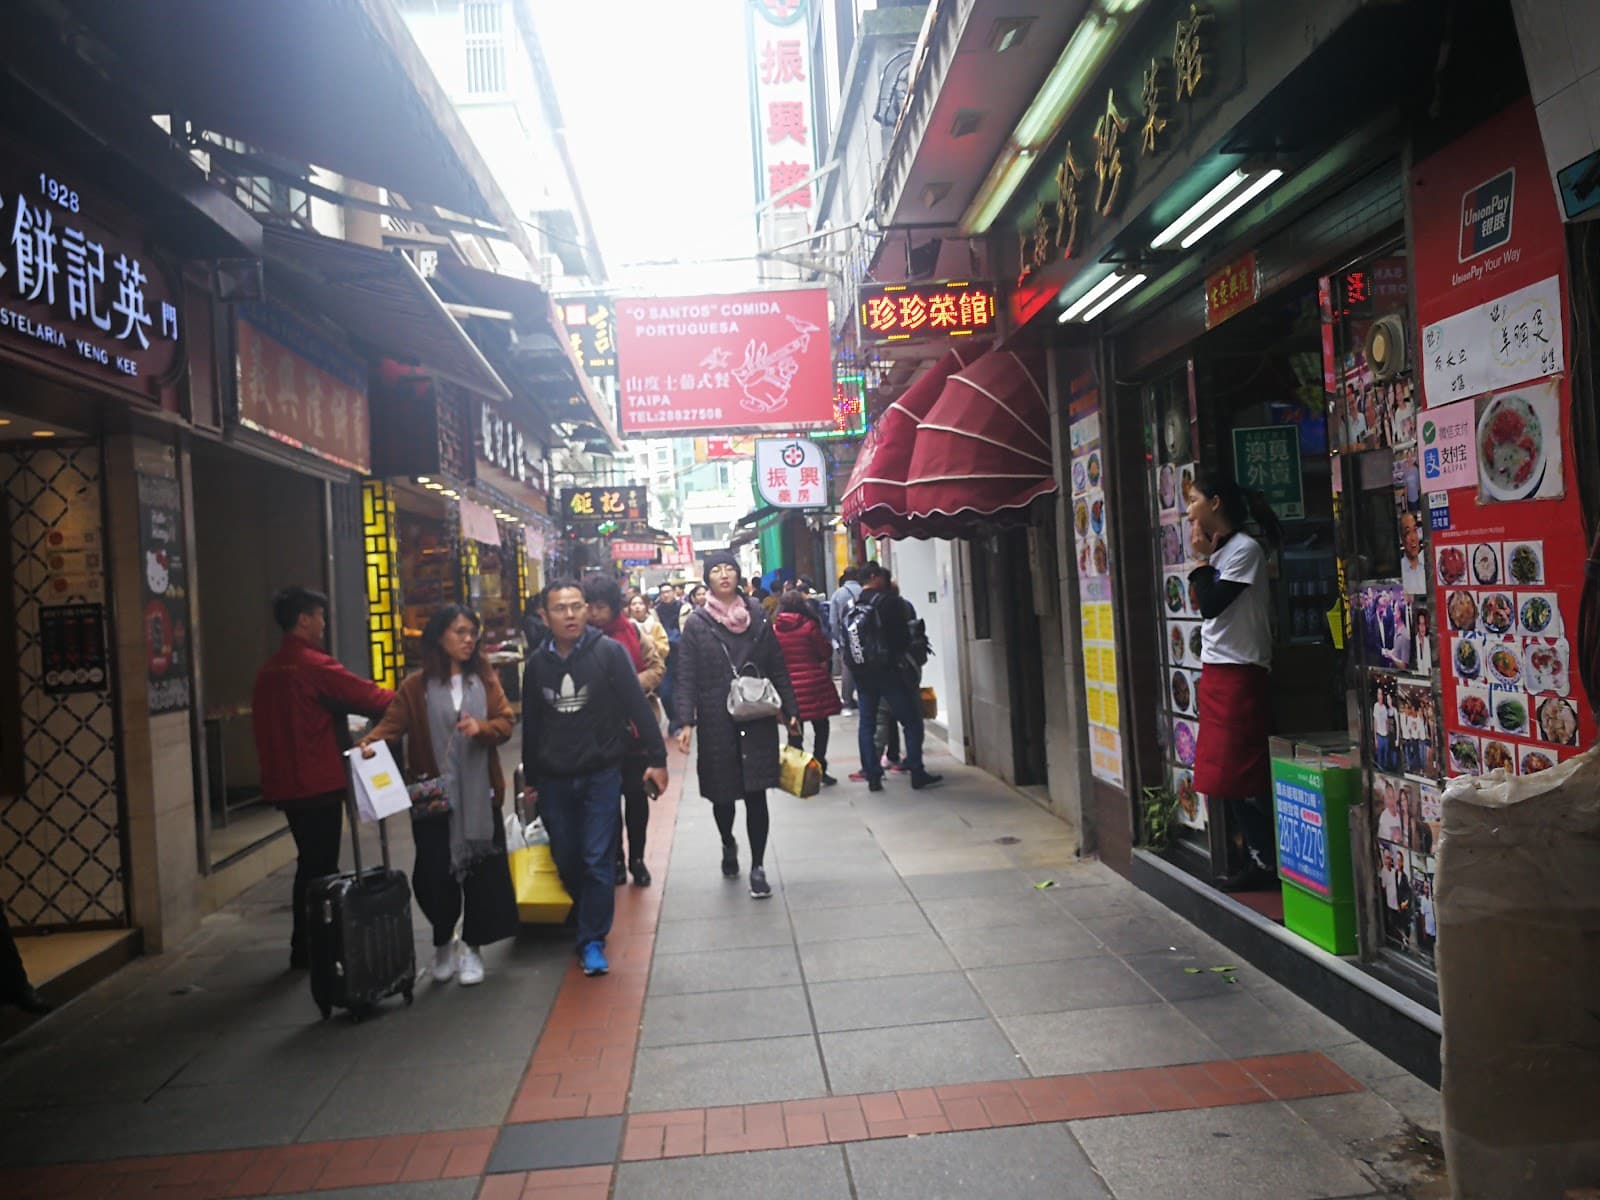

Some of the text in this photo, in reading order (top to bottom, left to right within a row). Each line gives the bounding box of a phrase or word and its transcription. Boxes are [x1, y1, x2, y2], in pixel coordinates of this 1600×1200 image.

[759, 39, 813, 234] 振興藥
[39, 172, 80, 213] 1928
[1464, 194, 1510, 226] UnionPay
[1452, 248, 1521, 286] UnionPay Your Way
[161, 301, 178, 341] 門
[721, 302, 781, 317] COMIDA
[868, 291, 988, 331] 珍珍菜館
[636, 321, 739, 337] PORTUGUESA
[75, 338, 109, 364] YENG
[116, 356, 138, 376] KEE
[628, 395, 671, 408] TAIPA
[1441, 444, 1467, 464] 支付宝
[1443, 463, 1467, 474] ALIPAY
[767, 467, 819, 487] 振興
[1278, 815, 1300, 858] 2875
[1301, 825, 1325, 869] 2279
